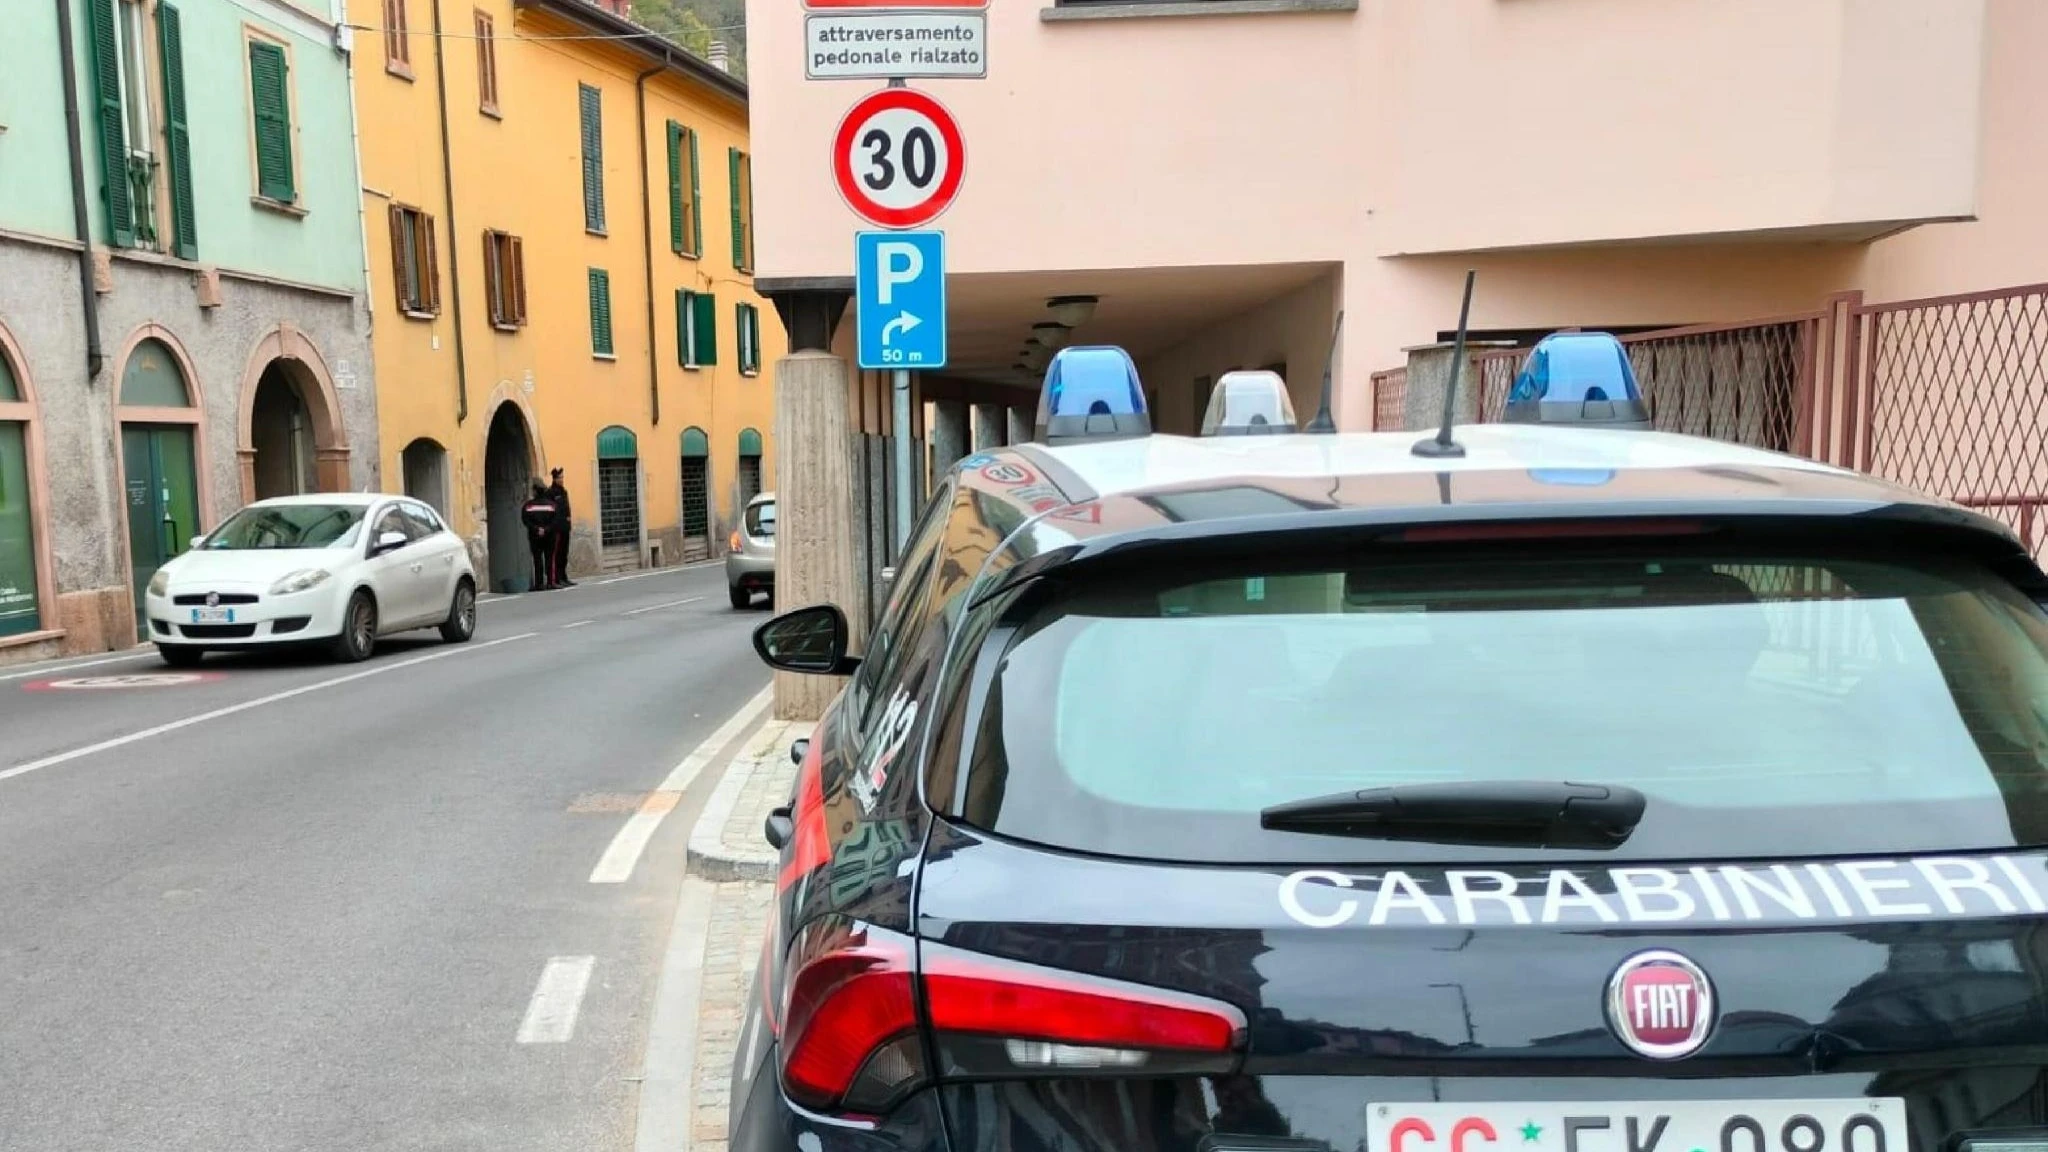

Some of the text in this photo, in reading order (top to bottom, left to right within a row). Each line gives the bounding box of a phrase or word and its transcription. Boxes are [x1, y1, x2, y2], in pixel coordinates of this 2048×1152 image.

[818, 25, 974, 42] attraversamento
[814, 47, 979, 68] pedonale rialzato
[862, 127, 936, 190] 30
[876, 242, 924, 304] P
[882, 349, 922, 362] 50 m
[1277, 856, 2047, 928] CARABINIERI
[1632, 983, 1691, 1029] FIAT
